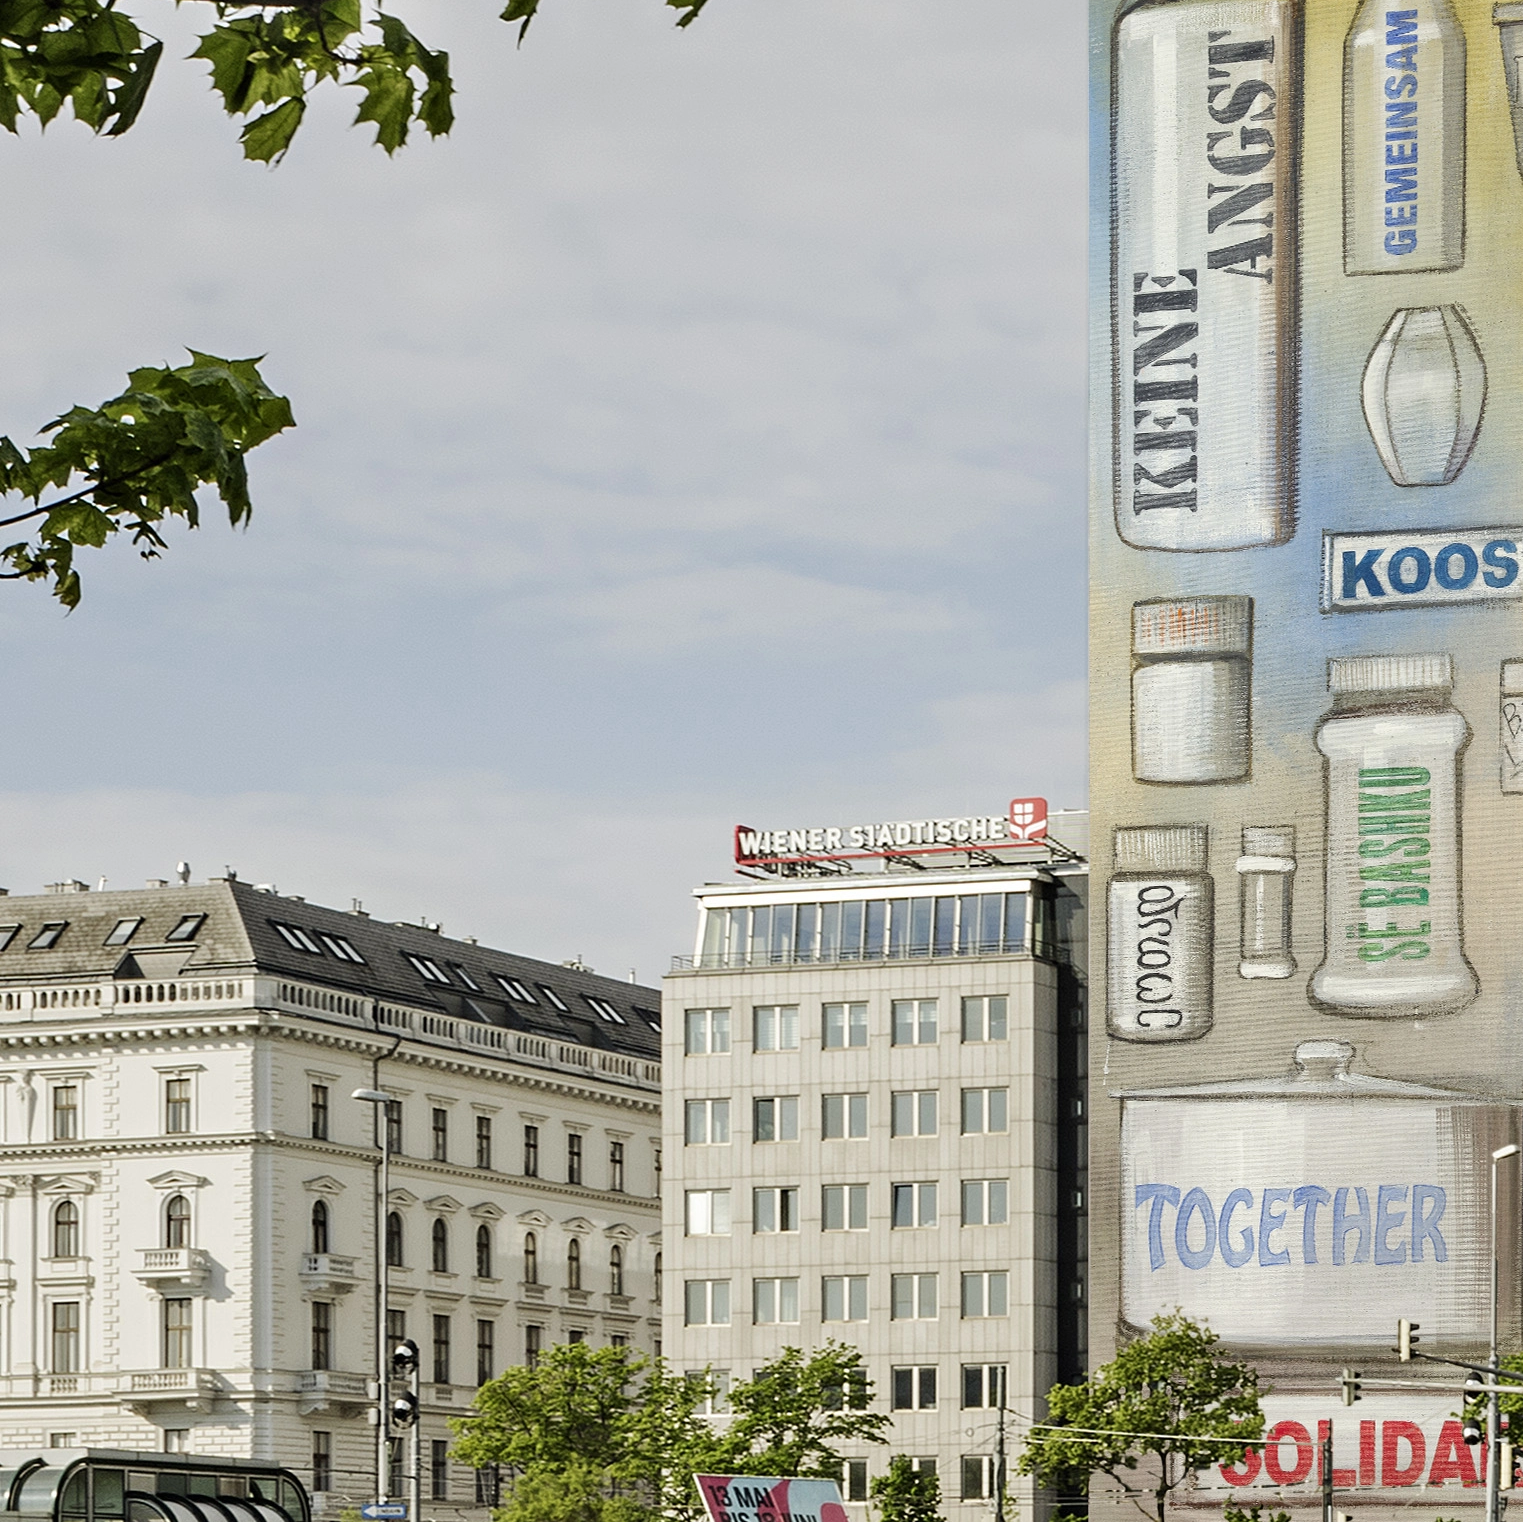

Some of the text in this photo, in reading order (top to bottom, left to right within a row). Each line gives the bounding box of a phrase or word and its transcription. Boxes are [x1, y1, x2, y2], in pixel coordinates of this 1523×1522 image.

[1384, 8, 1420, 257] GEMEINSAM
[1133, 29, 1277, 514] KEINE ANGST
[1341, 539, 1520, 601] KOOS
[738, 817, 1005, 856] WIENER STÄDTISCHE
[1358, 766, 1431, 908] BASHKU
[1135, 1183, 1448, 1271] TOGETHER
[709, 1485, 775, 1508] 13 MAI
